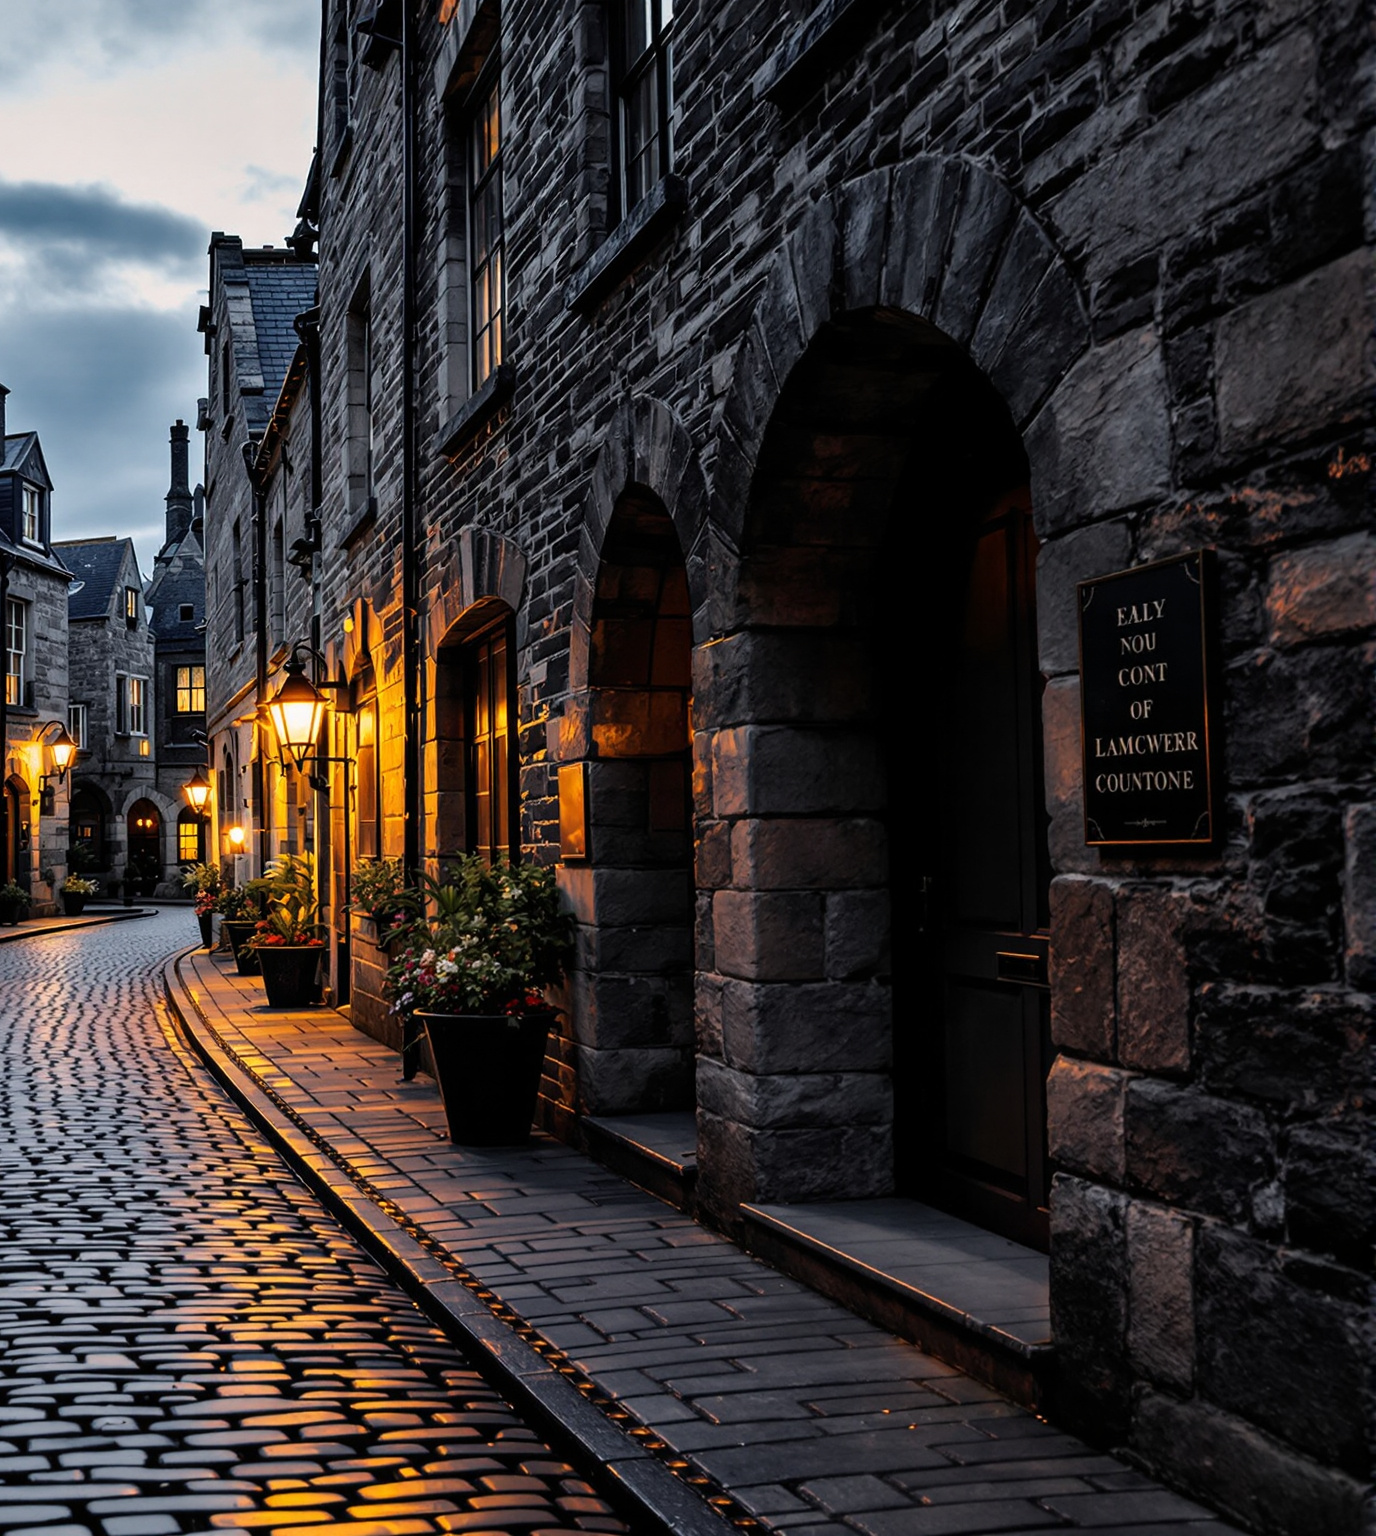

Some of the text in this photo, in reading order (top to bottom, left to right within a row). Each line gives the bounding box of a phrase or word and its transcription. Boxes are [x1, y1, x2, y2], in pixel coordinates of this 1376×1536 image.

[1117, 599, 1166, 627] EALY
[1120, 632, 1156, 655] NOU
[1118, 662, 1168, 687] CONT
[1130, 699, 1153, 720] OF
[1095, 731, 1198, 757] LAMCWERR
[1095, 770, 1194, 793] COUNTONE
